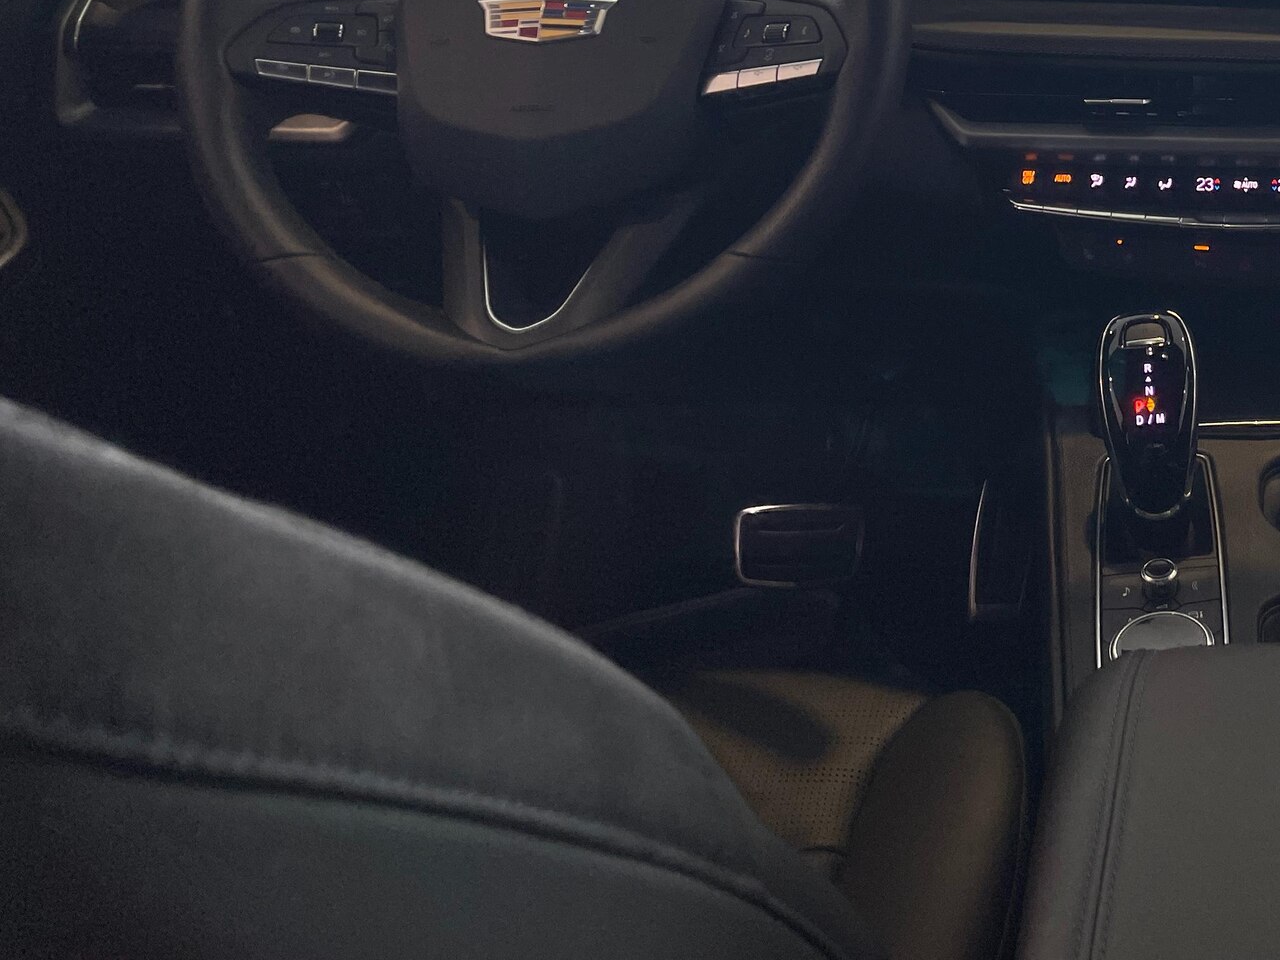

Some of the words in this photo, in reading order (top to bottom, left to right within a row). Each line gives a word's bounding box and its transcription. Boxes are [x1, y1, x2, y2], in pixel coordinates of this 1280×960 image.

[1054, 174, 1072, 183] AUTO
[1196, 177, 1214, 191] 23
[1143, 363, 1152, 373] R
[1145, 386, 1154, 396] N
